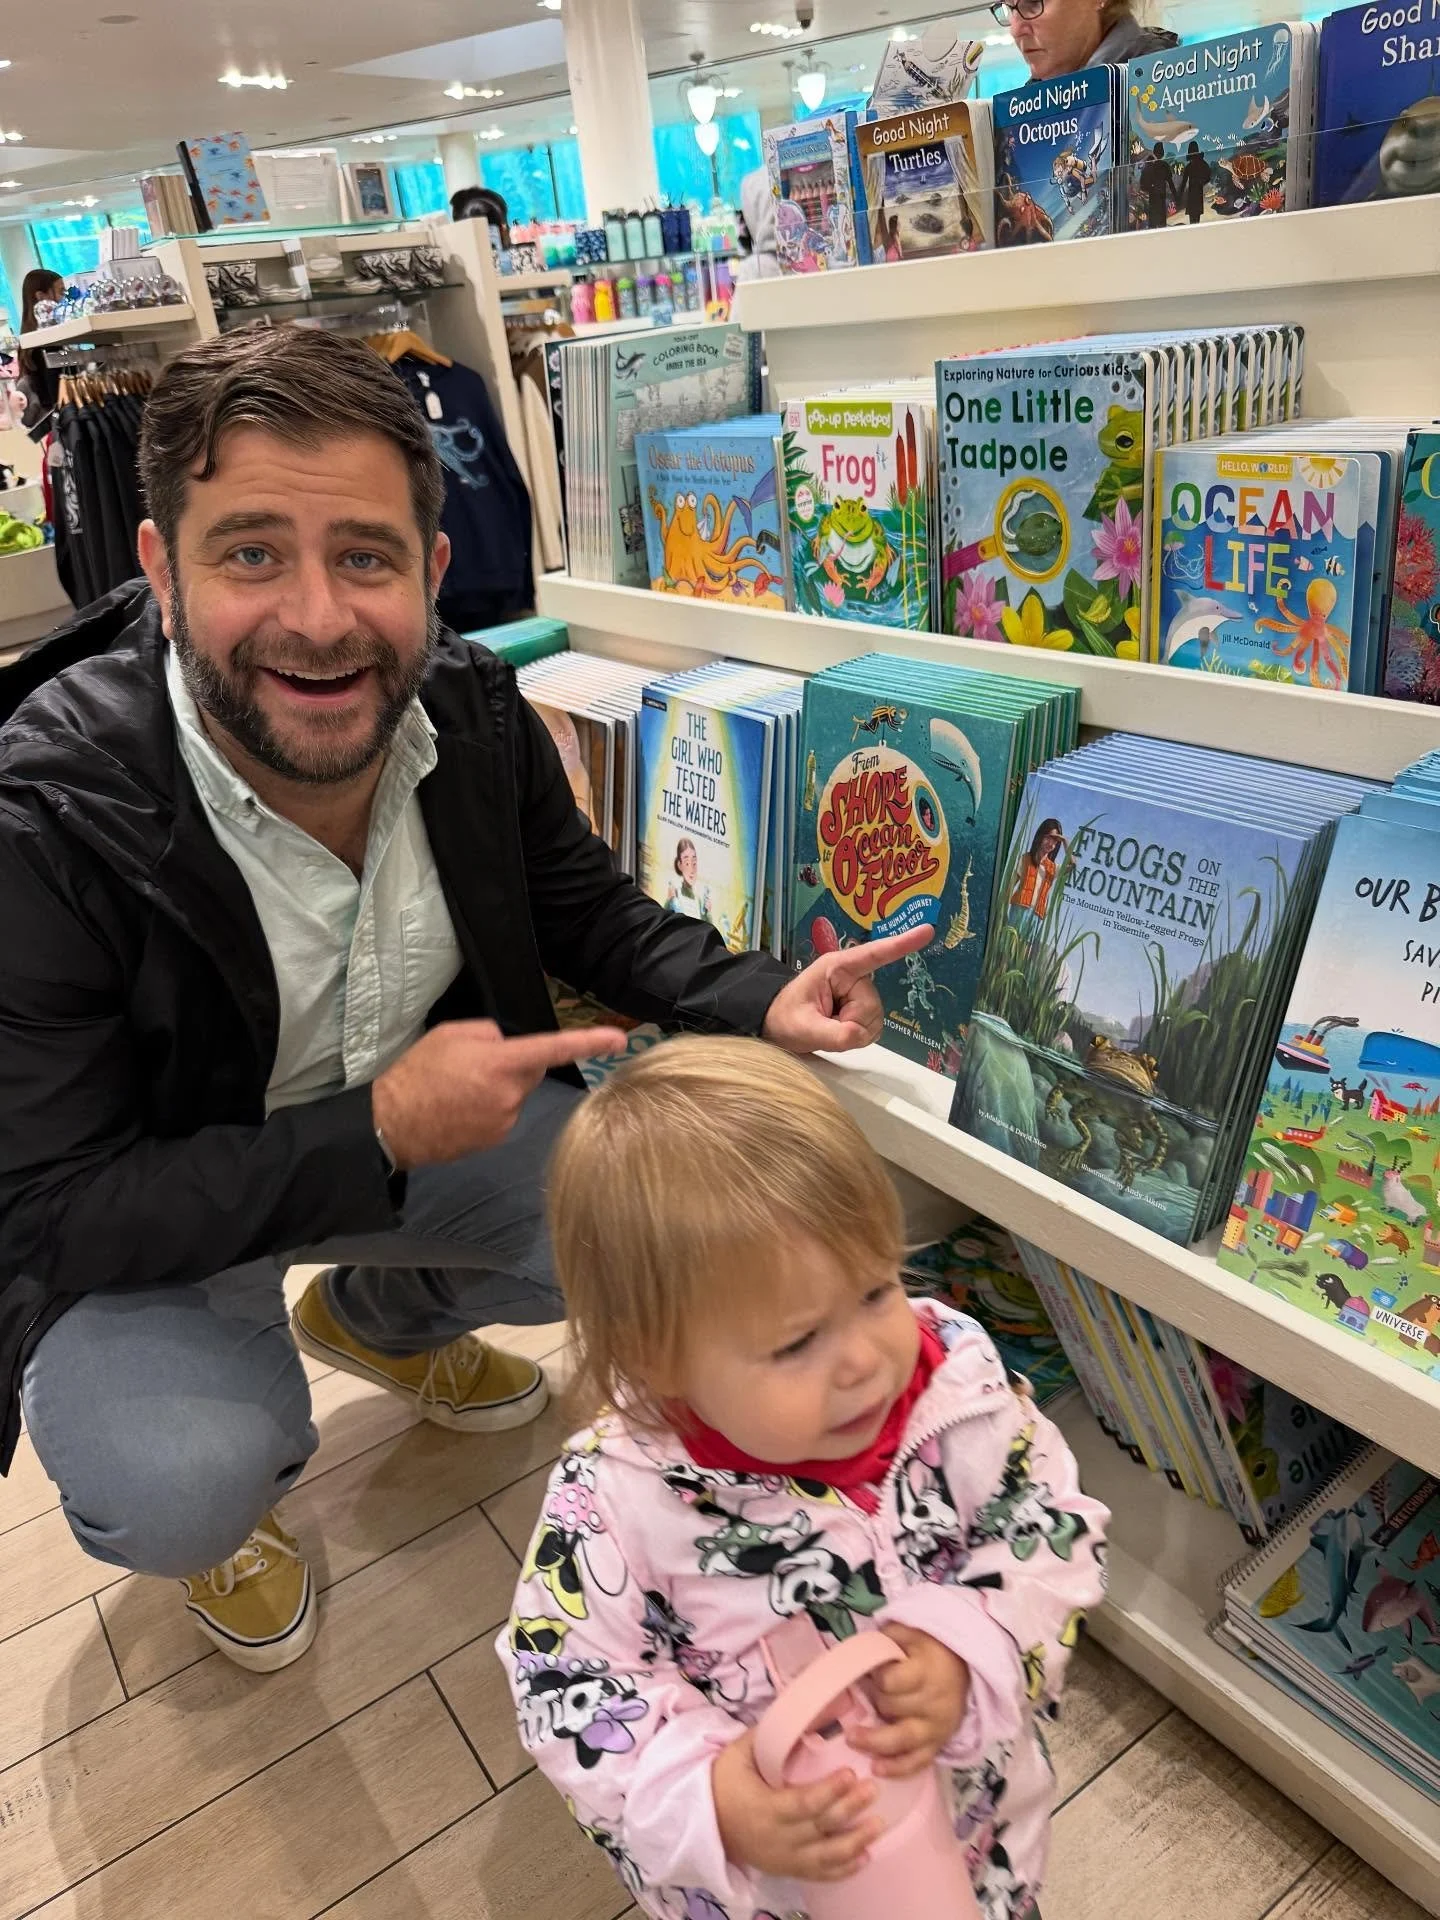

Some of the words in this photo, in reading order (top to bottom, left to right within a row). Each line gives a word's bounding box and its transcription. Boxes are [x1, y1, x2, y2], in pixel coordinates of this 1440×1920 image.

[1361, 0, 1423, 34] Good
[1151, 54, 1198, 84] Good
[1204, 37, 1263, 73] Night
[1009, 88, 1042, 118] Good
[1046, 79, 1089, 109] Night
[1159, 71, 1257, 113] Aquarium
[873, 121, 906, 146] Good
[909, 112, 950, 140] Night
[1018, 116, 1079, 146] Octopus
[889, 149, 942, 174] Turtles
[653, 343, 696, 366] COLORING
[696, 343, 720, 359] BOOK
[944, 369, 994, 383] Exploring
[996, 367, 1035, 380] Nature
[1038, 368, 1051, 378] for
[1054, 364, 1100, 378] Curious
[1102, 363, 1130, 376] Kids
[808, 408, 841, 430] pop-up
[945, 391, 1001, 424] One
[1012, 388, 1094, 424] Little
[648, 444, 682, 470] Oscar
[686, 450, 702, 471] the
[703, 445, 756, 481] Octopus
[822, 444, 877, 498] Frog
[947, 437, 1068, 477] Tadpole
[1170, 482, 1335, 544] OCEAN
[1204, 535, 1290, 599] LIFE
[1222, 633, 1232, 644] Jill
[1233, 635, 1271, 650] McDonald
[686, 711, 708, 742] THE
[671, 736, 694, 766] GIRL
[697, 744, 723, 776] WHO
[852, 751, 881, 775] From
[675, 766, 716, 803] TESTED
[662, 789, 683, 818] THE
[685, 797, 727, 836] WATERS
[820, 765, 913, 847] SHORE
[823, 848, 832, 863] to
[832, 823, 921, 896] Ocean
[1071, 825, 1187, 886] FROGS
[1197, 858, 1223, 877] ON
[854, 839, 940, 919] Floor
[1188, 876, 1220, 898] THE
[1355, 876, 1411, 915] OUR
[1064, 866, 1215, 931] MOUNTAIN
[876, 923, 889, 934] THE
[887, 911, 908, 930] HUMAN
[898, 922, 910, 934] THE
[908, 911, 925, 926] DEEP
[1062, 892, 1076, 905] The
[1076, 897, 1115, 917] Mountain
[1115, 909, 1177, 937] Yellow-Legged
[1178, 931, 1205, 948] Frogs
[1102, 918, 1111, 928] in
[1113, 920, 1150, 941] Yosemite
[912, 1031, 941, 1051] NIELSEN
[1125, 1185, 1145, 1200] Andy
[1375, 1310, 1425, 1340] UNIVERSE
[1388, 1478, 1436, 1529] SKETCHBOOK
